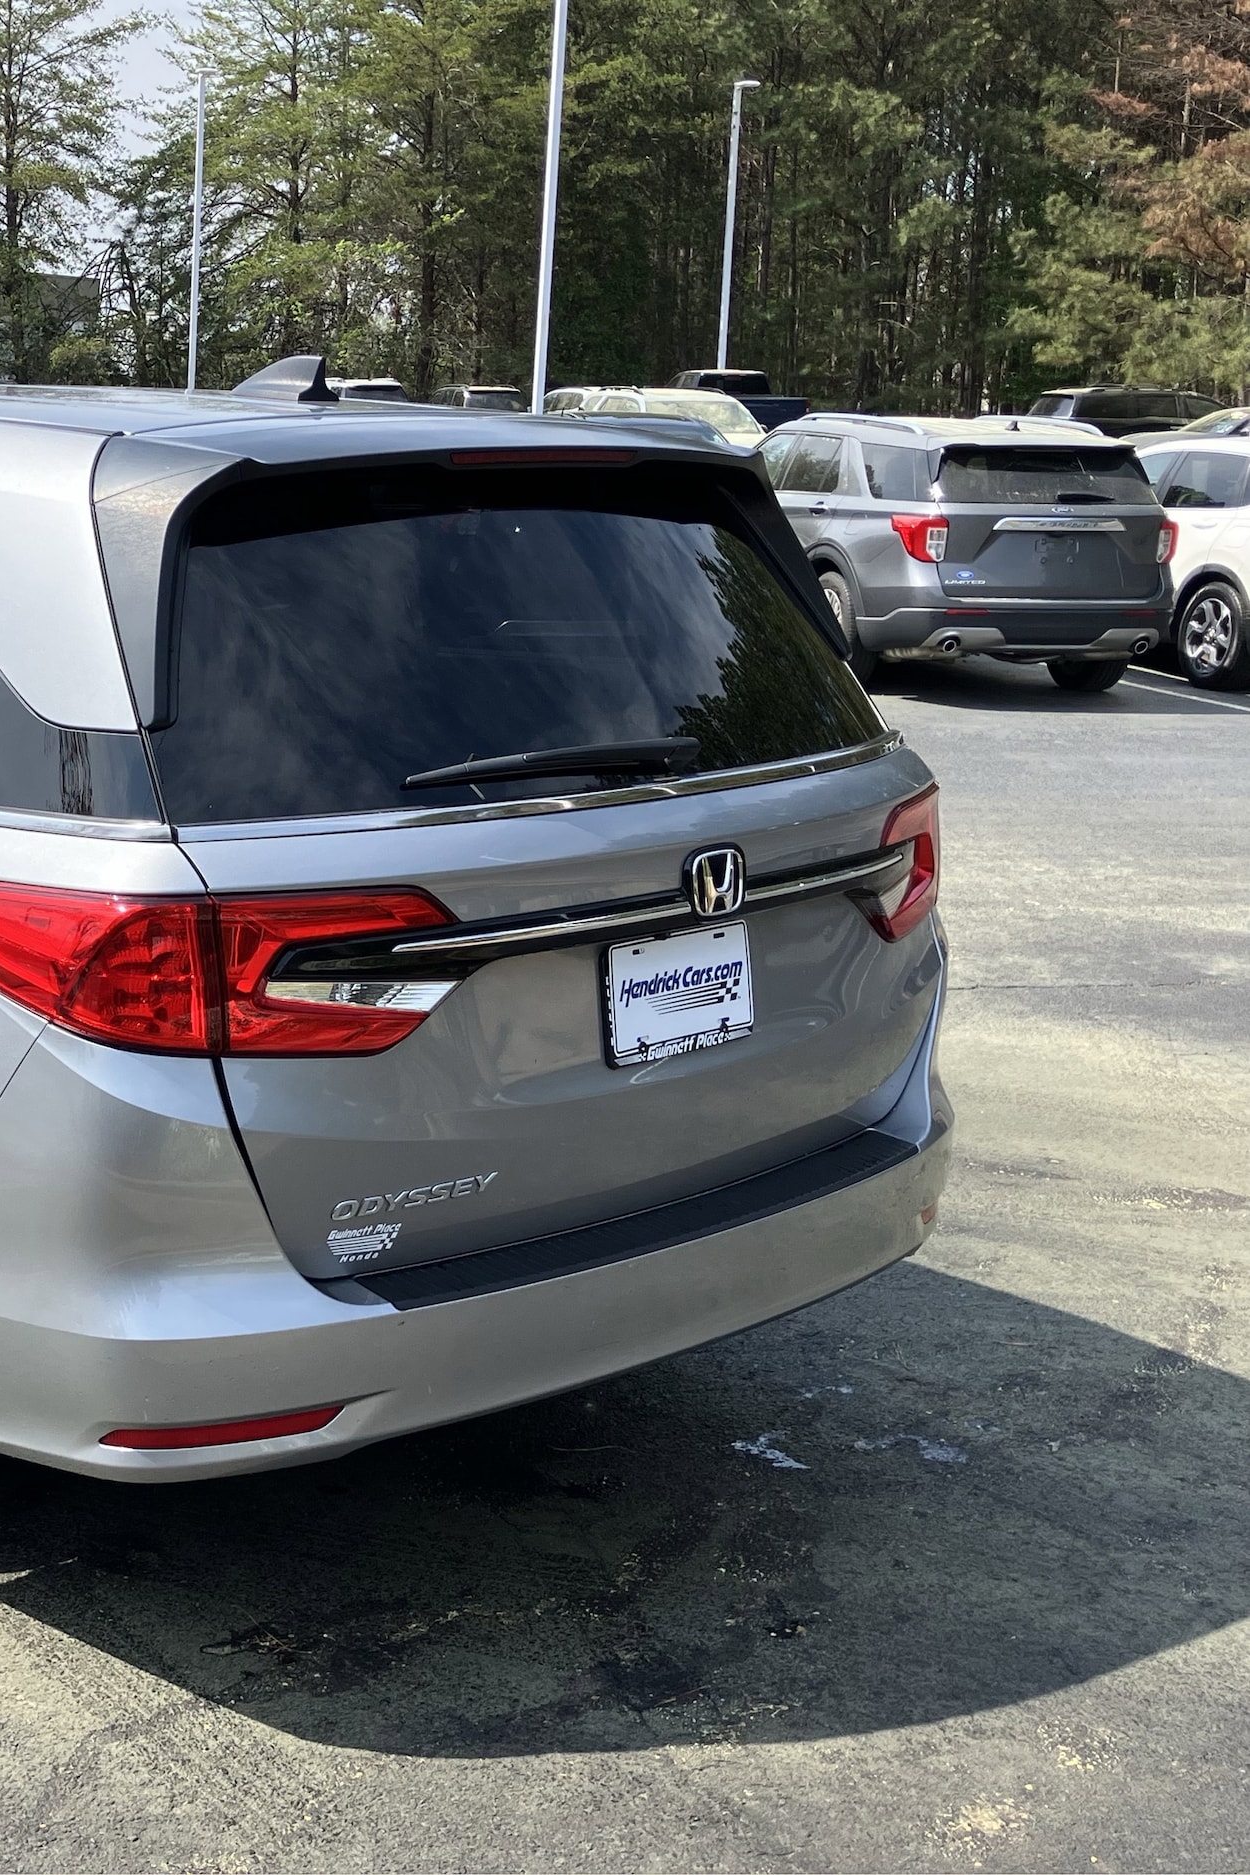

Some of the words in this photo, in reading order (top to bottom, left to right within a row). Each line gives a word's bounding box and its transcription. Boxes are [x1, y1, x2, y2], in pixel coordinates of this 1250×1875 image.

[647, 1035, 697, 1062] Gwinnett
[695, 1031, 725, 1050] Place
[331, 1170, 499, 1221] ODYSSEY
[327, 1225, 373, 1240] Gwinnett
[373, 1222, 402, 1235] Place
[339, 1252, 379, 1263] Honda
